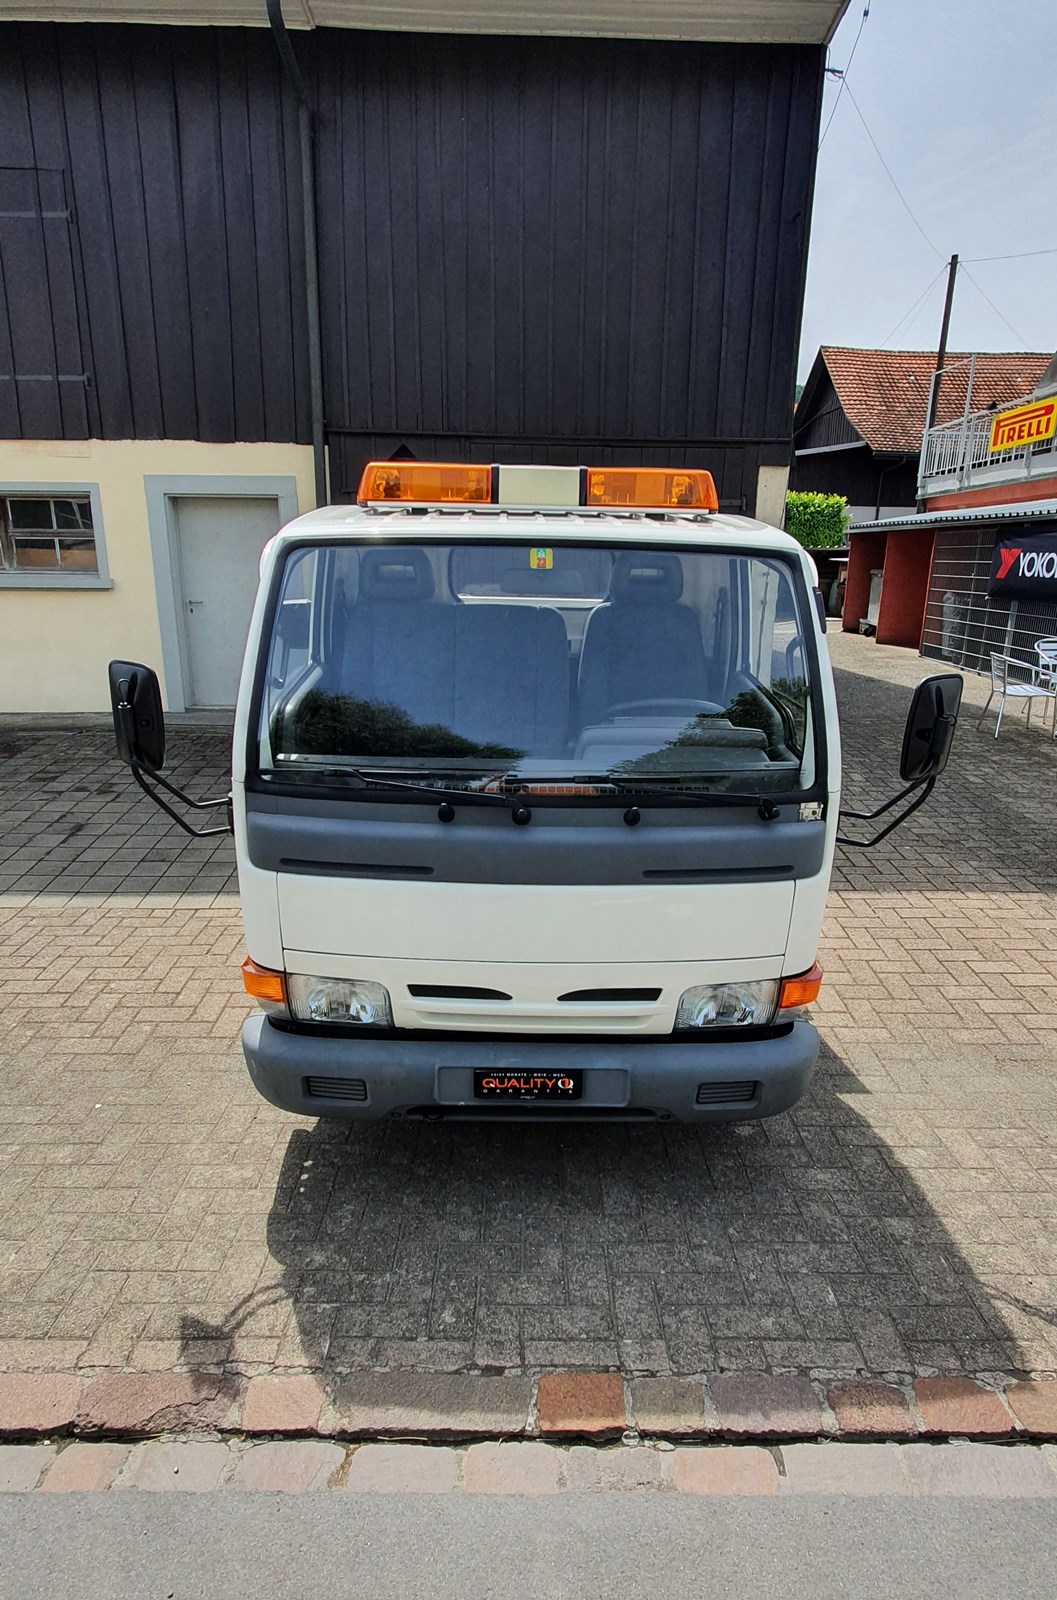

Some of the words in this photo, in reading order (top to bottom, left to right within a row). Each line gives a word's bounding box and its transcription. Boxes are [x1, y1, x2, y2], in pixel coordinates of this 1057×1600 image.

[992, 403, 1055, 447] PIRELLI
[1018, 552, 1057, 578] YOKO
[482, 1078, 556, 1089] QUALITY
